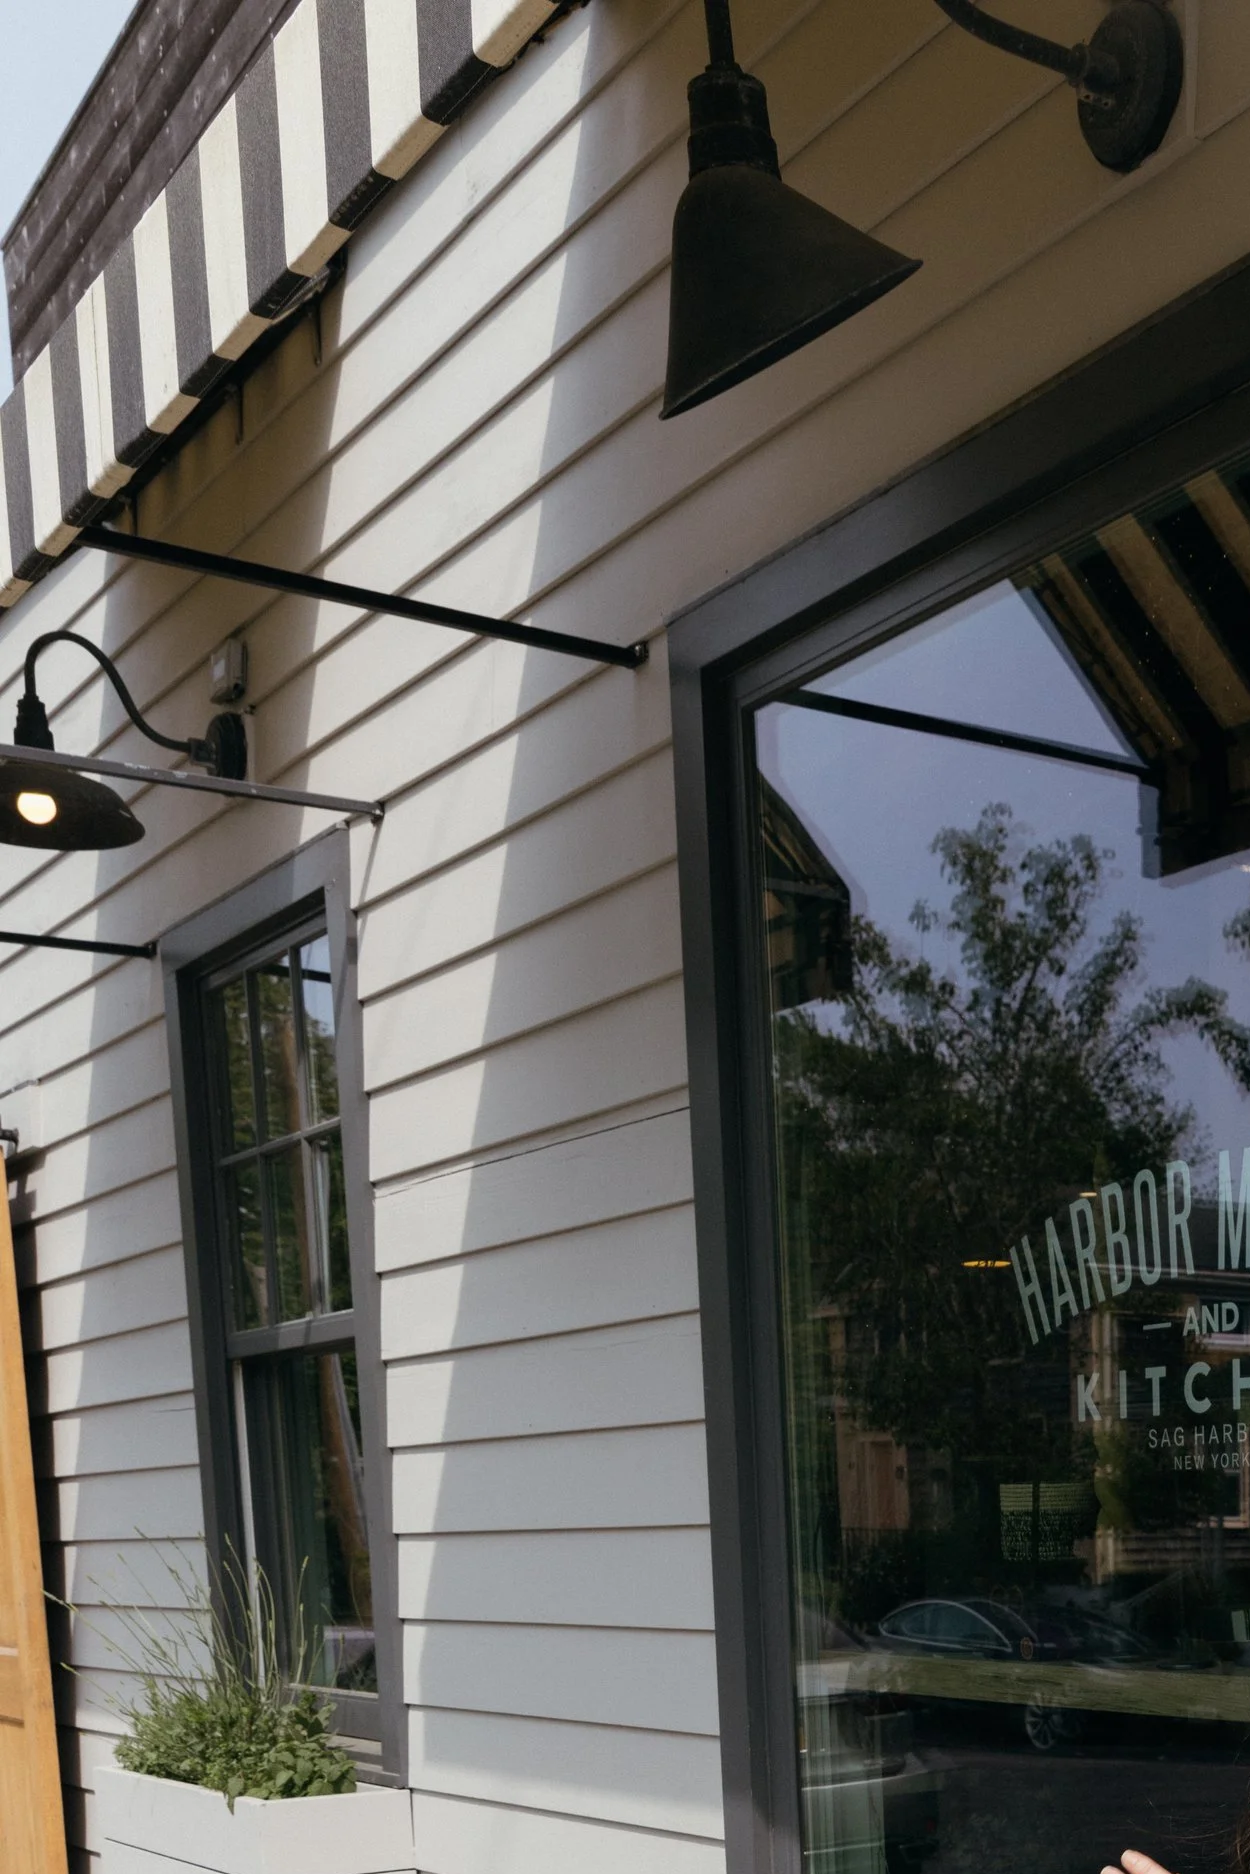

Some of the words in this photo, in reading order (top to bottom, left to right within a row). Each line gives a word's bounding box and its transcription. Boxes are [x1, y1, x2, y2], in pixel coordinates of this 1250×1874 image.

[1010, 1160, 1195, 1346] HARBOR
[1182, 1302, 1240, 1337] AND
[1148, 1425, 1185, 1448] SAG
[1173, 1453, 1206, 1471] NEW
[1211, 1450, 1250, 1469] YORK
